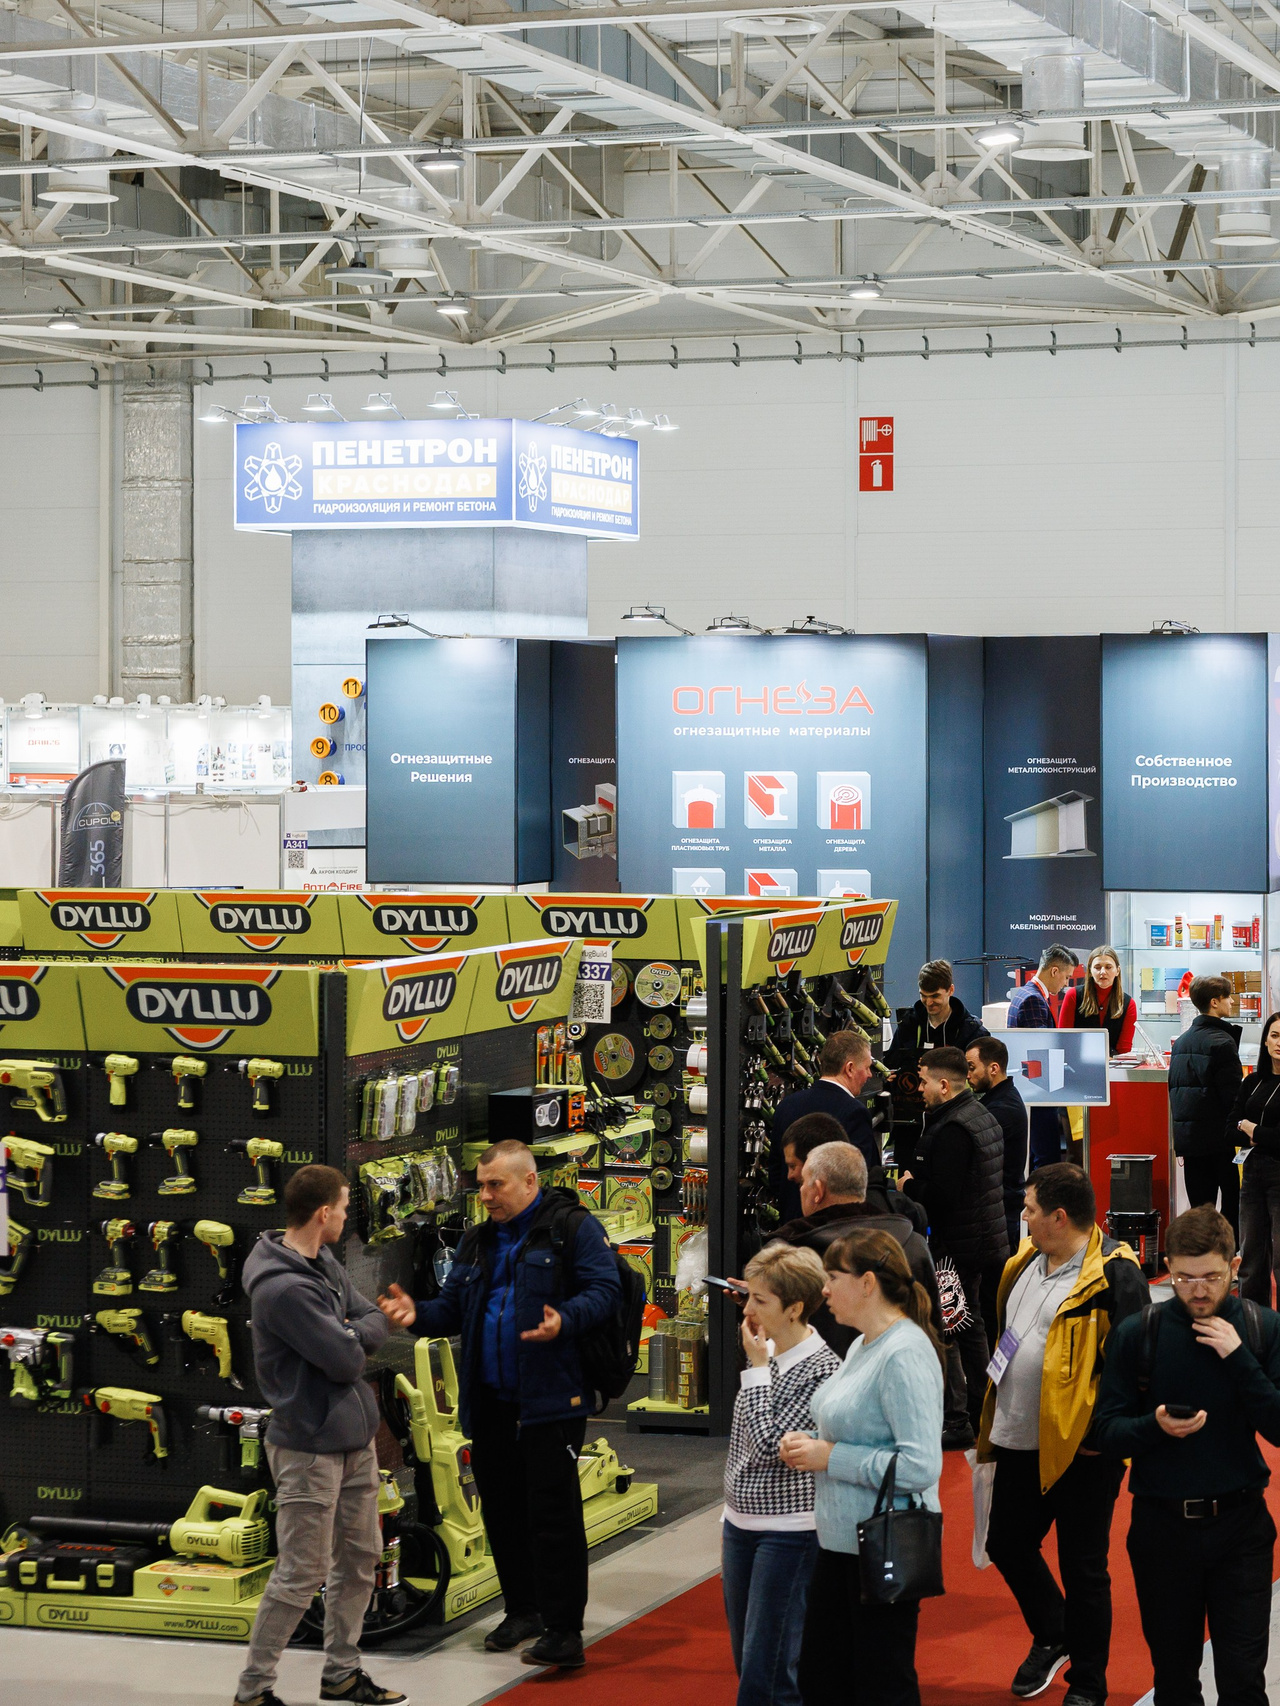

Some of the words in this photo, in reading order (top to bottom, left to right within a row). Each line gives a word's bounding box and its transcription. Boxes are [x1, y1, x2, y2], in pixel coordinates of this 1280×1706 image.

[312, 438, 497, 466] ПЕНЕТРОН
[551, 444, 632, 481] ПЕНЕТРОН
[318, 472, 491, 495] КРАСНОДАР
[553, 481, 630, 507] КРАСНОДАР
[313, 502, 400, 514] ГИДРОИЗОЛЯЦИЯ
[403, 503, 410, 512] И
[413, 502, 455, 512] РЕМОНТ
[457, 501, 496, 511] БЕТОНА
[551, 506, 591, 521] ГИДРОИЗОЛЯЦИЯ
[592, 511, 596, 520] И
[596, 511, 614, 523] РЕМОНТ
[615, 515, 632, 526] БЕТОНА
[343, 680, 360, 695] 11
[672, 686, 875, 715] ОГНЕЗА
[320, 706, 337, 720] 10
[673, 726, 780, 738] огнезащитные
[789, 726, 871, 738] материалы
[315, 740, 324, 754] 9
[390, 752, 493, 765] Огнезащитные
[568, 757, 616, 765] ОГНЕЗАЩИТА
[1027, 757, 1077, 765] ОГНЕЗАЩИТА
[1135, 754, 1233, 768] Собственное
[1008, 766, 1097, 774] МЕТАЛЛОКОНСТРУКЦИЙ
[324, 775, 333, 785] 8
[410, 772, 472, 783] Решения
[1131, 775, 1238, 788] Производство
[285, 840, 306, 849] A341
[90, 840, 105, 876] 365
[340, 882, 363, 890] FIRE
[58, 905, 143, 928] DYLLU
[217, 908, 302, 931] DYLLU
[380, 909, 469, 932] DYLLU
[549, 909, 639, 937] DYLLU
[1029, 914, 1077, 922] МОДУЛЬНЫЕ
[842, 917, 882, 946] DYLLU
[1010, 923, 1054, 931] КАБЕЛЬНЫЕ
[1056, 923, 1097, 931] ПРОХОДКИ
[770, 928, 814, 958] DYLLU
[500, 955, 560, 996] DYLLU
[138, 986, 260, 1019] DYLLU
[387, 976, 452, 1016] DYLLU
[437, 1044, 459, 1059] DYLLU
[286, 1064, 313, 1076] LLU
[436, 1126, 458, 1142] DYLLU
[281, 1151, 313, 1163] YLLU
[37, 1229, 82, 1241] DYLLU
[37, 1315, 81, 1327] DYLLU
[37, 1486, 82, 1500] DYLLU
[187, 1536, 219, 1547] DYLLU
[457, 1589, 477, 1607] DYLLU
[48, 1609, 89, 1622] DYLLU
[163, 1619, 239, 1632] www.DYLLU.com
